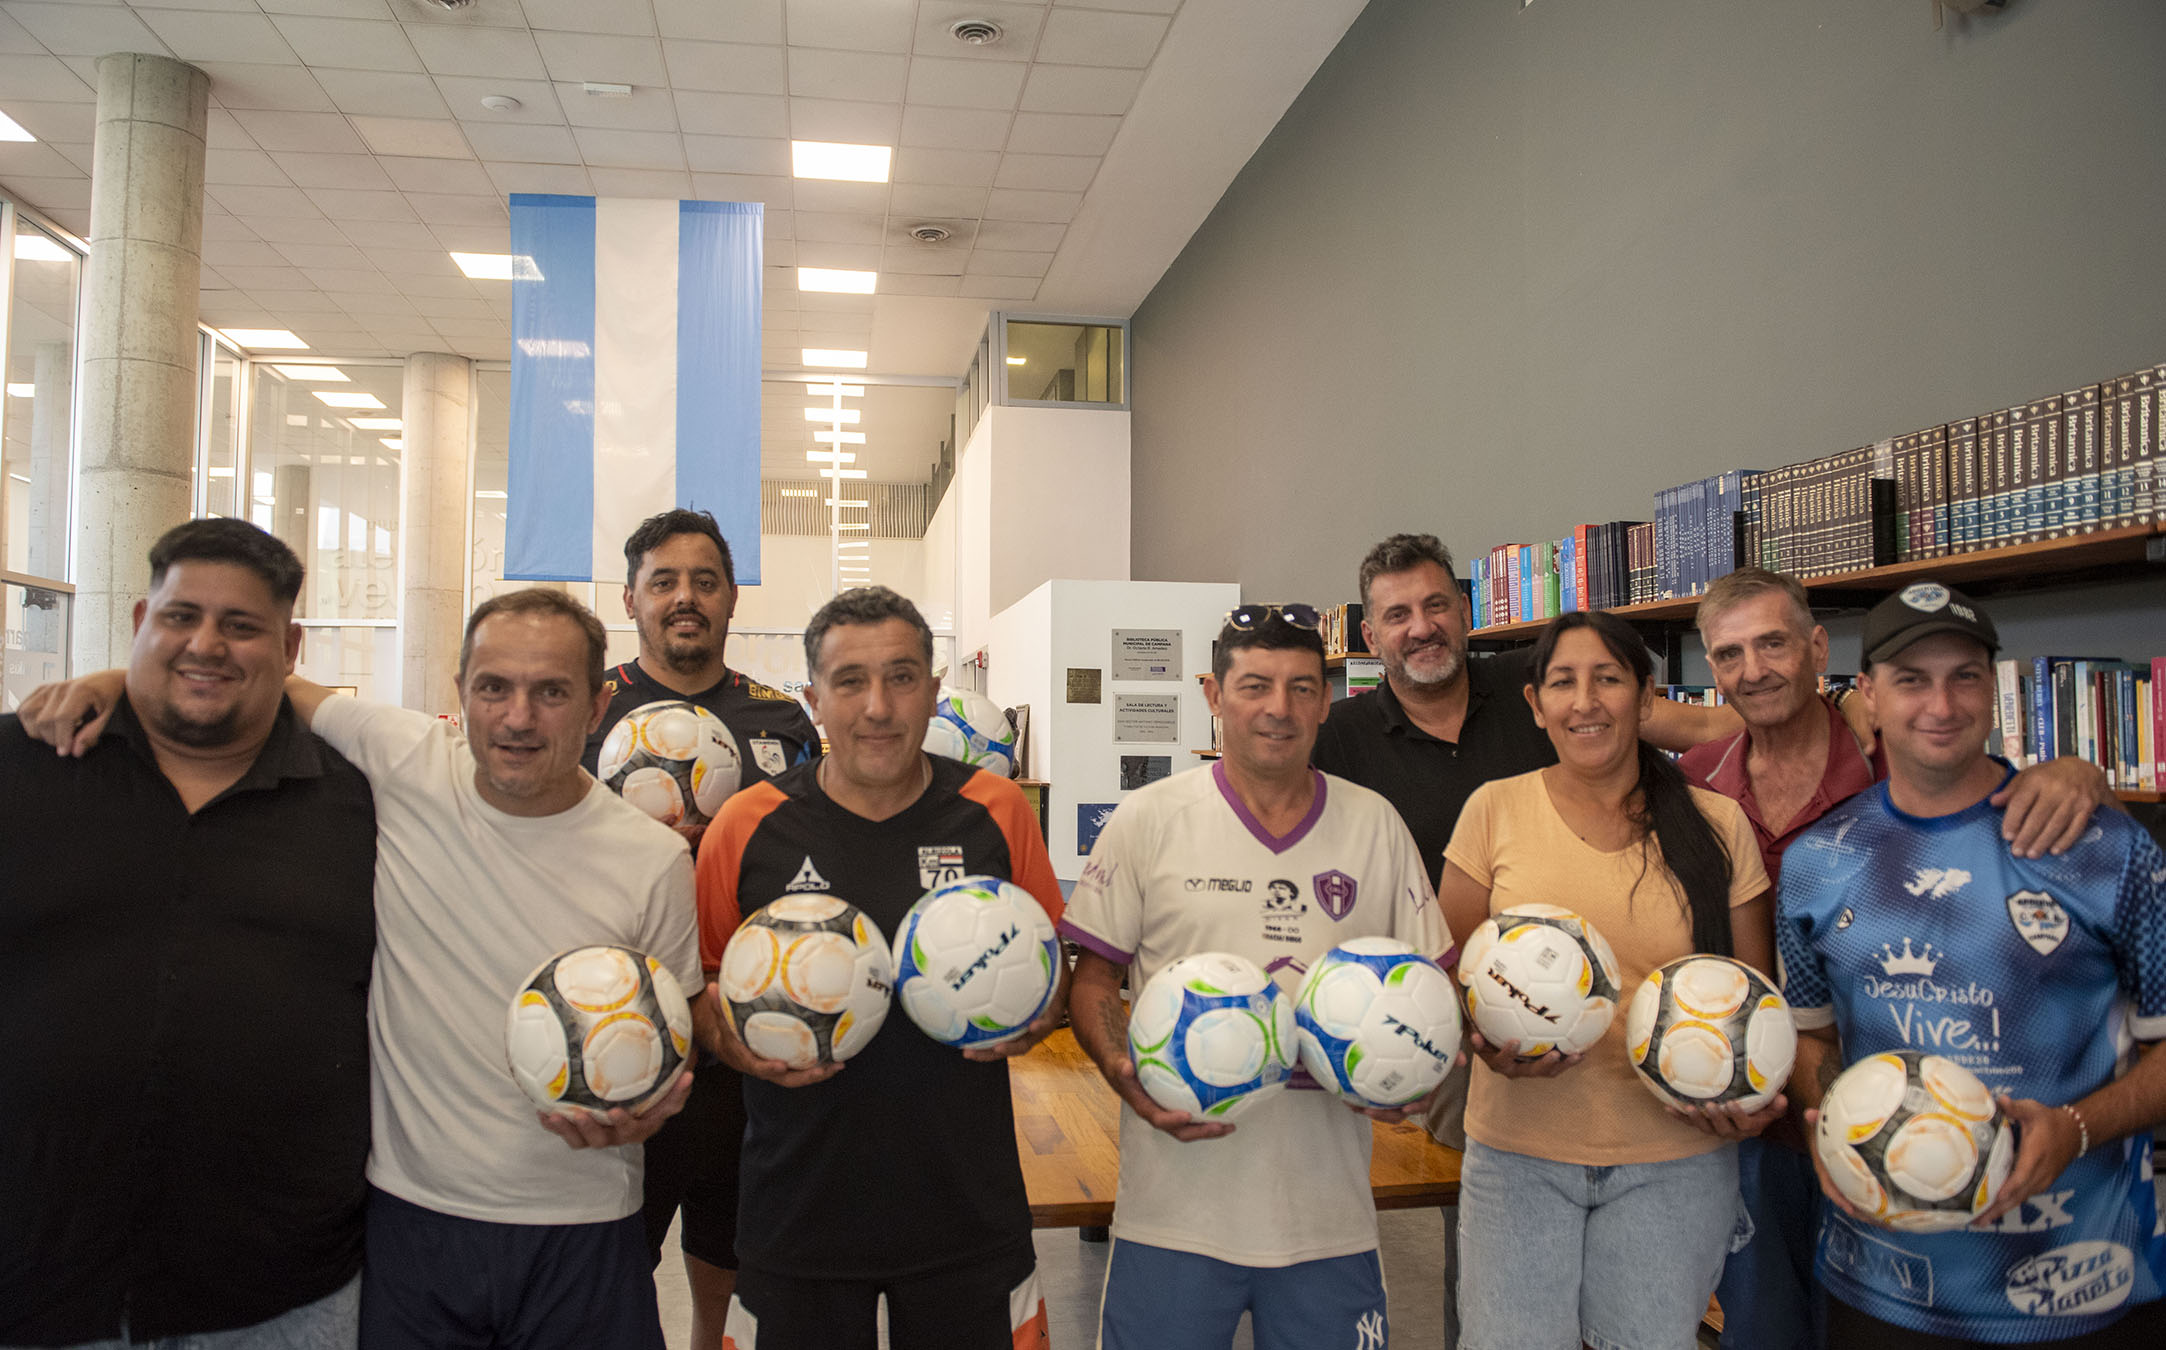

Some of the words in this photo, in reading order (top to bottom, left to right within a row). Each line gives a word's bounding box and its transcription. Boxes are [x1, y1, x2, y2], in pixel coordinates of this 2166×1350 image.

[2031, 424, 2040, 479] Britannica
[2049, 420, 2058, 476] Britannica
[2068, 415, 2077, 472] Britannica
[2085, 410, 2094, 468] Britannica
[2104, 406, 2113, 464] Britannica
[2121, 401, 2131, 460] Britannica
[2140, 395, 2150, 456] Britannica
[1909, 454, 1918, 504] Britannica
[1922, 452, 1931, 502] Britannica
[1964, 441, 1974, 493] Britannica
[1981, 437, 1990, 490] Britannica
[1997, 434, 2006, 487] Britannica
[2014, 429, 2023, 484] Britannica
[928, 869, 958, 888] 70
[2016, 1267, 2130, 1315] Planeta
[2037, 1247, 2112, 1283] Pizza
